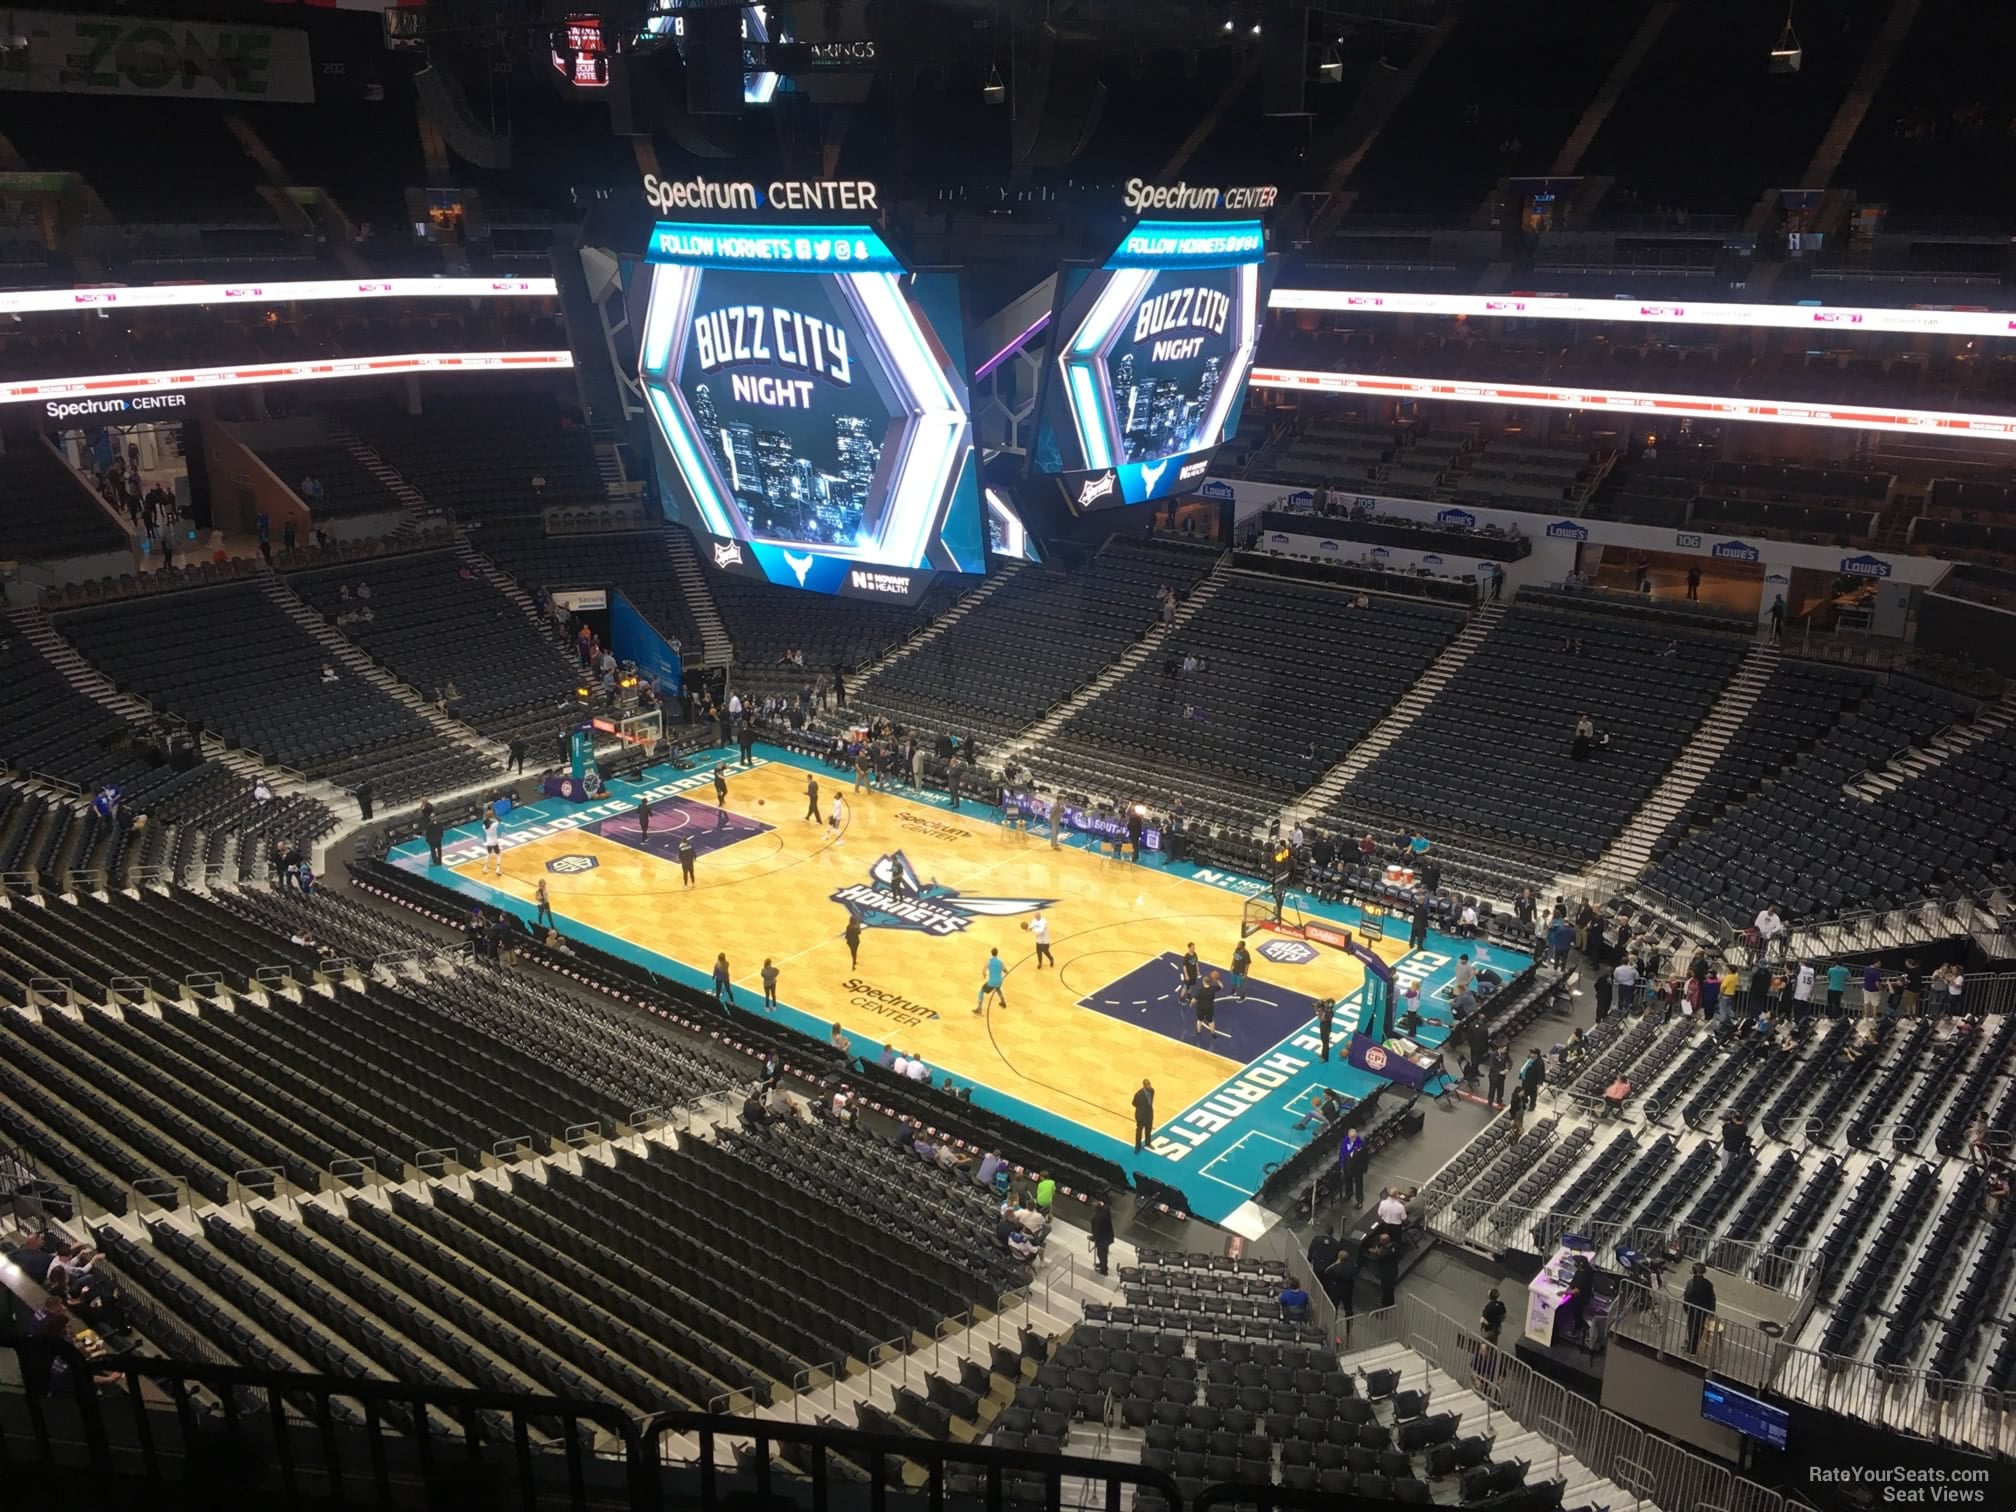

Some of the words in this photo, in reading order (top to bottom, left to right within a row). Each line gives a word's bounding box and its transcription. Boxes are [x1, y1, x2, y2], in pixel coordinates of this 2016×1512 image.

[62, 22, 271, 94] ZONE
[644, 174, 757, 215] Spectrum
[768, 181, 878, 210] CENTER
[1124, 177, 1220, 214] Spectrum
[1225, 185, 1278, 209] CENTER
[659, 234, 714, 256] FOLLOW
[717, 237, 793, 259] HORNETS
[1127, 237, 1177, 253] FOLLOW
[1177, 237, 1226, 254] HORNETS
[1133, 287, 1195, 343] BUZZ
[1191, 287, 1230, 335] CITY
[695, 306, 770, 370] BUZZ
[773, 309, 852, 384] CITY
[1152, 337, 1204, 362] NIGHT
[732, 374, 814, 409] NIGHT
[46, 399, 125, 419] Spectrum
[132, 394, 186, 410] CENTER
[1204, 486, 1233, 498] LOWE'S
[1440, 513, 1473, 526] LOWE'S
[1550, 527, 1586, 539] LOWE'S
[1678, 535, 1700, 548] 106
[1715, 546, 1755, 560] LOWE'S
[874, 573, 910, 586] NOVANT
[1844, 559, 1888, 576] LOWE'S
[876, 582, 908, 594] HEALTH
[894, 812, 968, 837] Spectrum
[902, 823, 957, 842] CENTER
[836, 885, 968, 934] HORNETS
[1802, 975, 1813, 985] 15
[842, 978, 938, 1019] Spectrum
[850, 997, 922, 1028] CENTER
[1368, 1055, 1385, 1066] CPI
[1144, 1052, 1311, 1162] HORNETS
